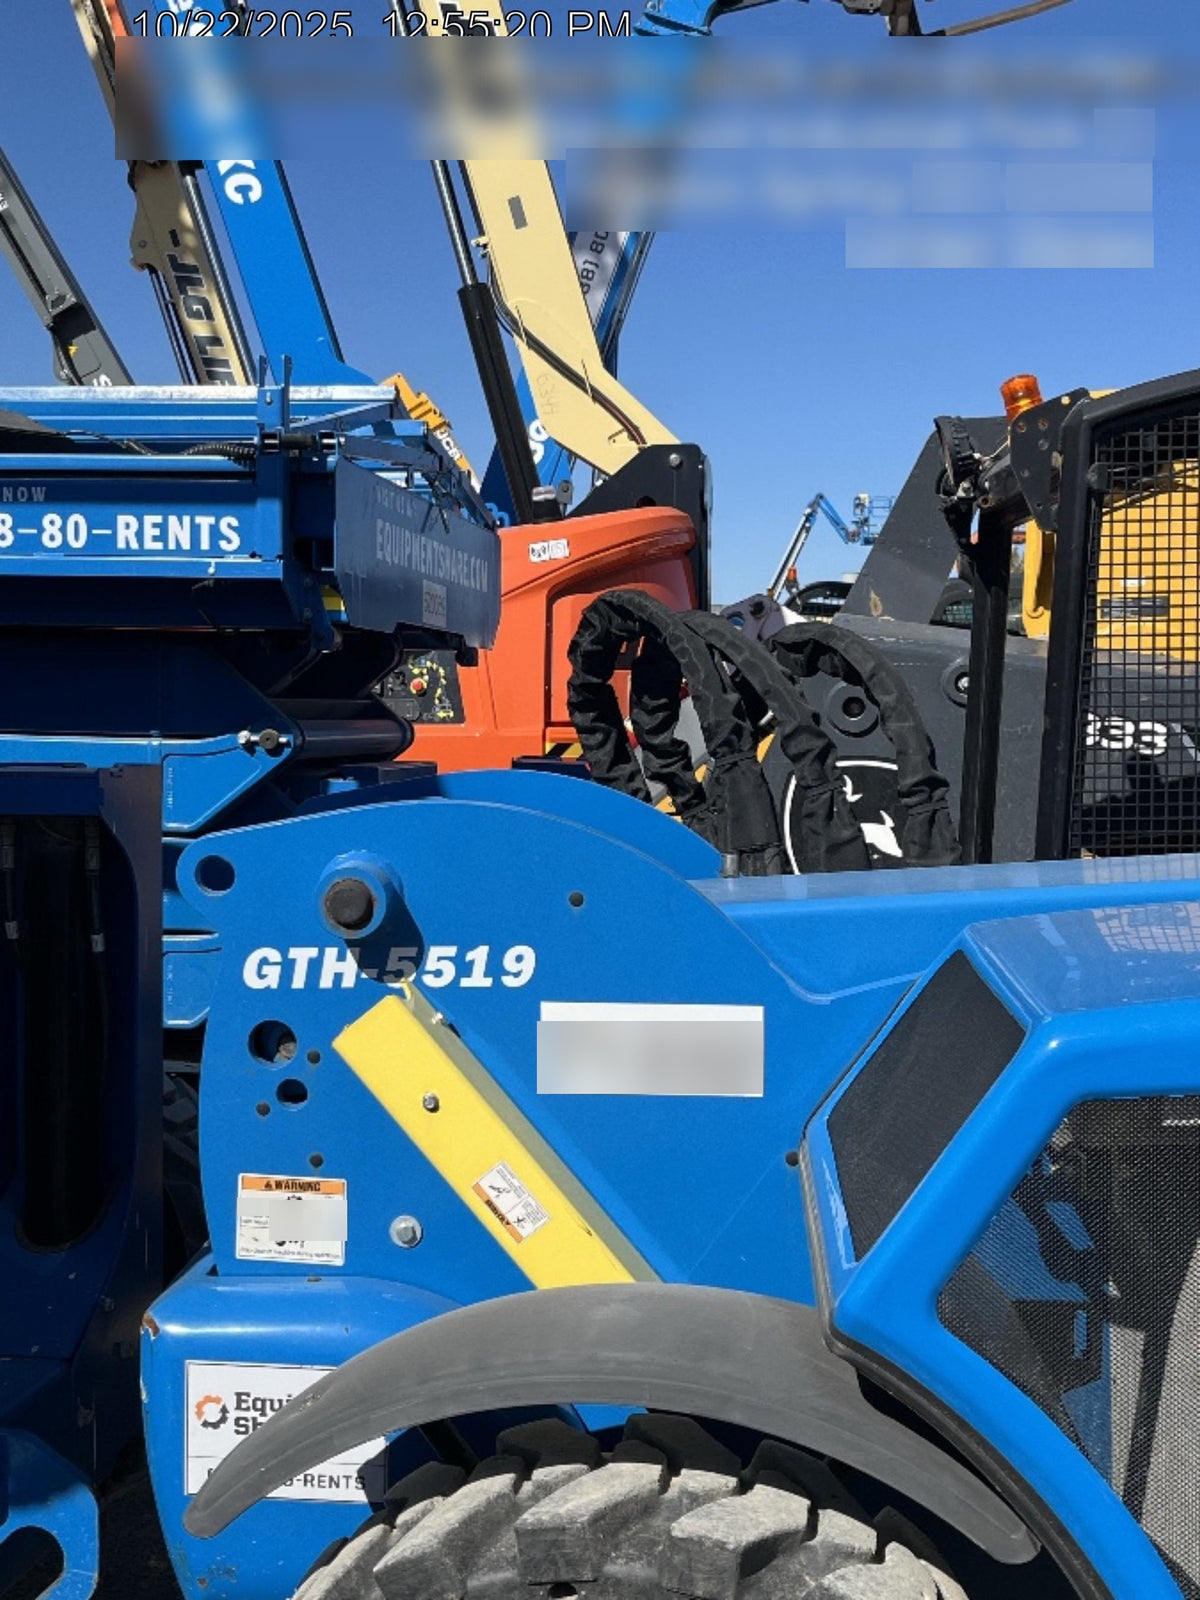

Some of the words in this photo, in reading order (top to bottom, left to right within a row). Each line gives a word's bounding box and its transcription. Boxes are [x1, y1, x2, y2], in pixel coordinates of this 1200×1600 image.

[166, 252, 216, 324] JLG
[2, 486, 47, 502] NOW
[242, 945, 536, 989] GTH-5519
